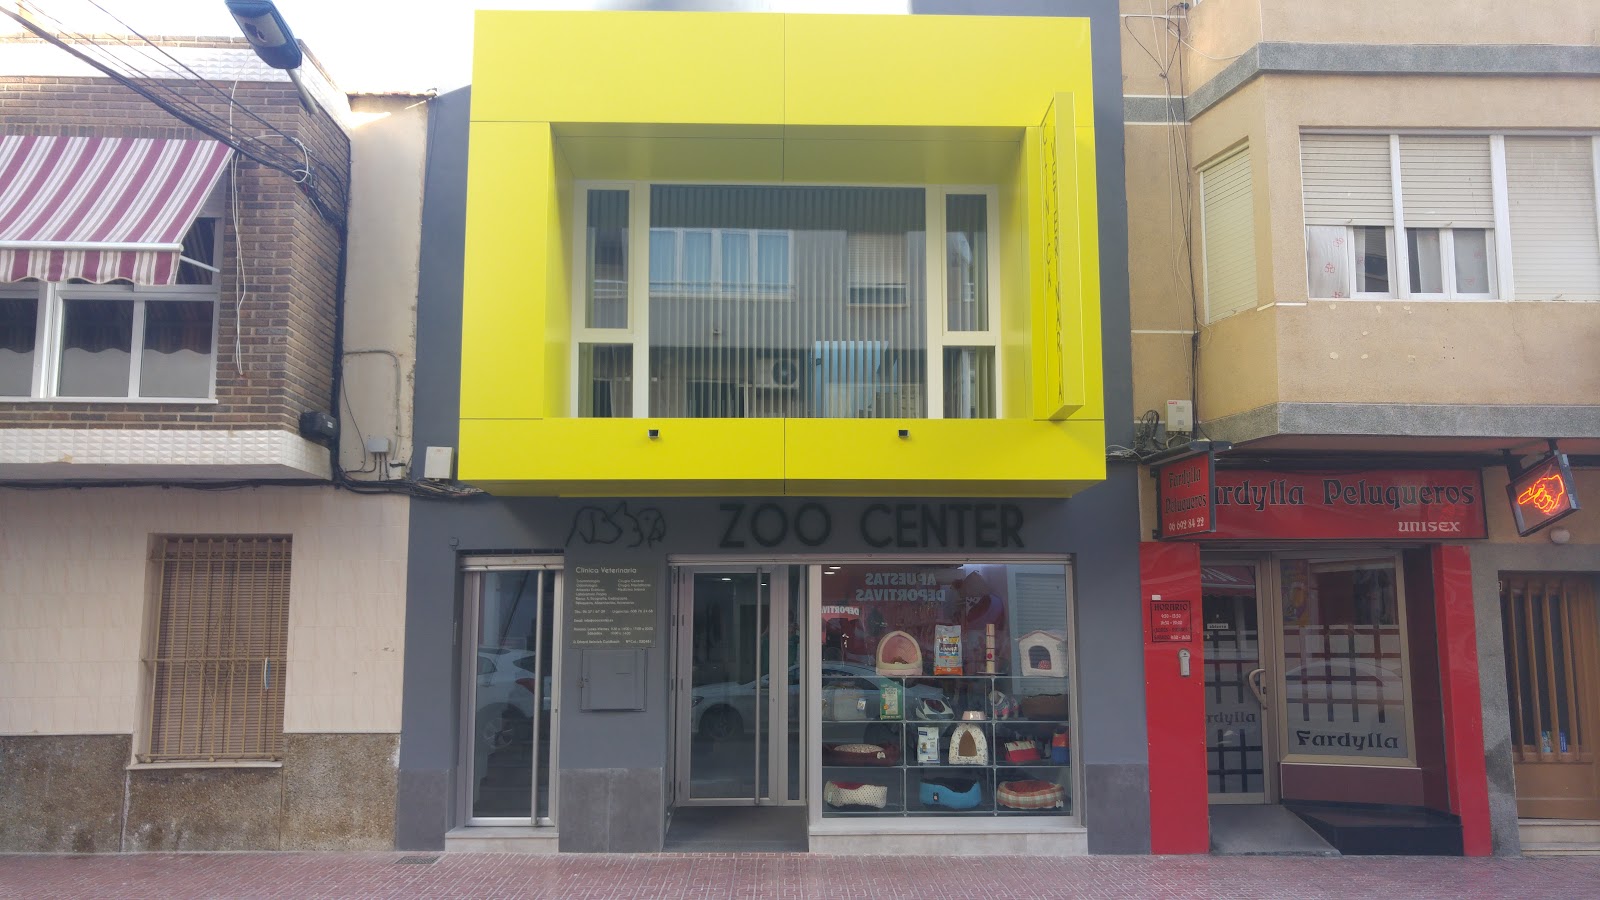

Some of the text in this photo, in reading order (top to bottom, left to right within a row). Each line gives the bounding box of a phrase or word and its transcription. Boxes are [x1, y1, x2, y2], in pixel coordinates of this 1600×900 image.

[1168, 466, 1201, 489] Fardylla
[1165, 493, 1207, 516] Peluqueros
[1322, 479, 1475, 511] Peluqueros
[719, 502, 1025, 548] ZOO CENTER
[1296, 730, 1401, 751] Fardylla
